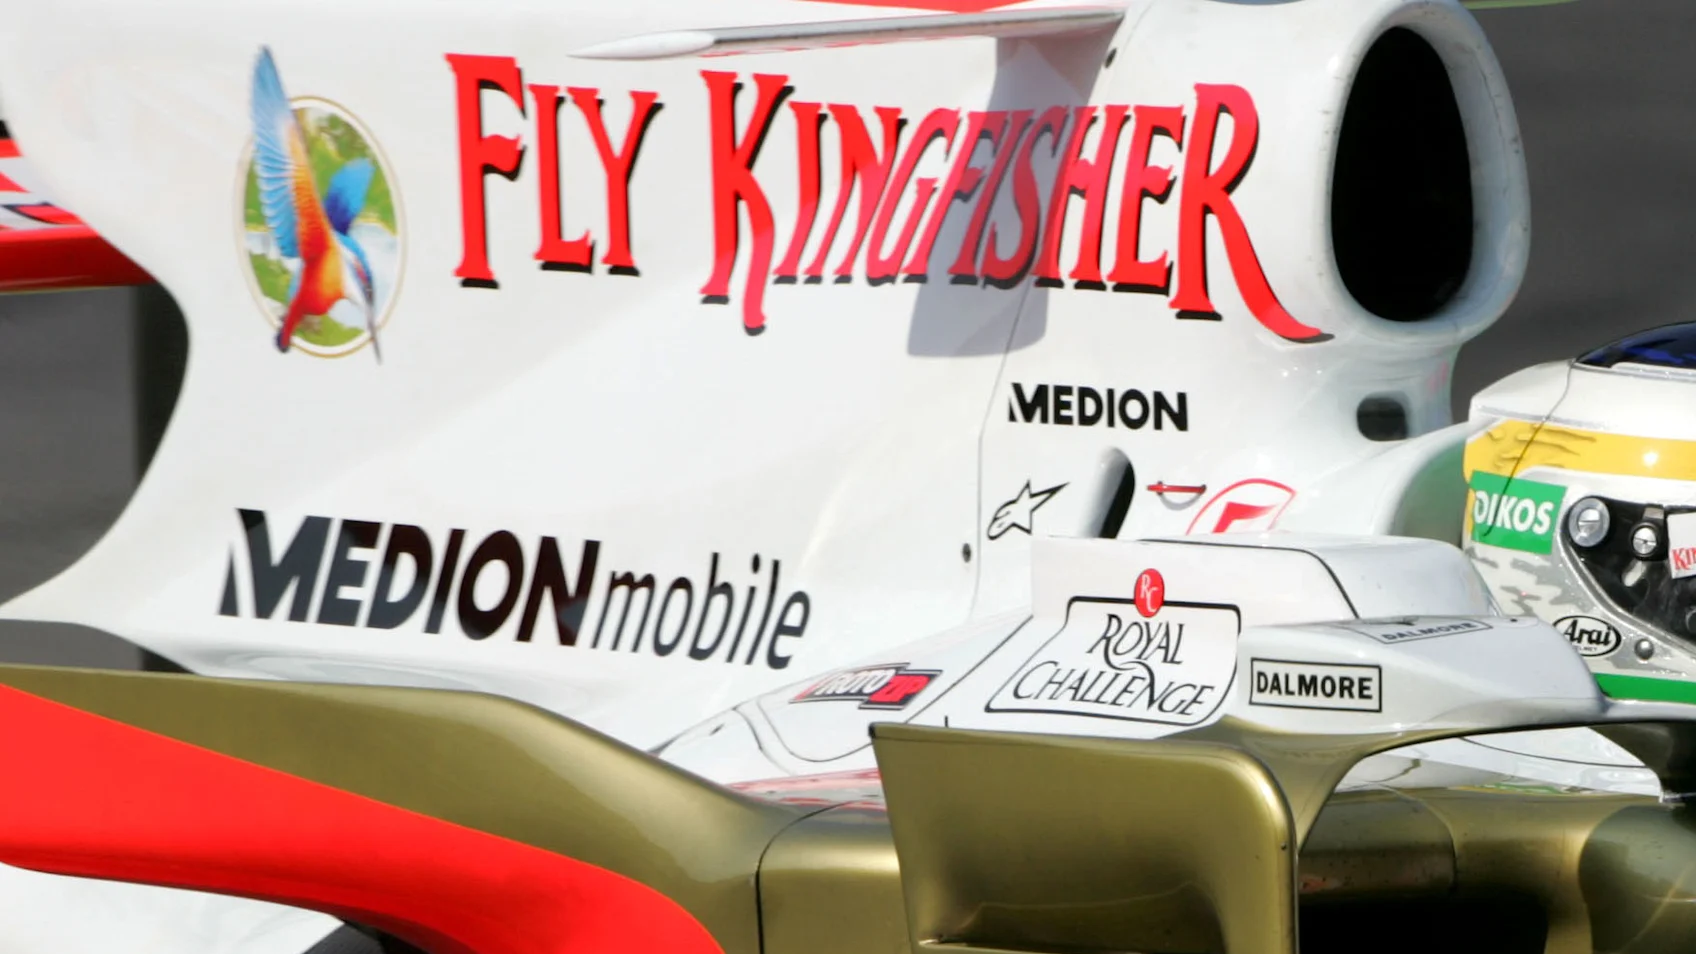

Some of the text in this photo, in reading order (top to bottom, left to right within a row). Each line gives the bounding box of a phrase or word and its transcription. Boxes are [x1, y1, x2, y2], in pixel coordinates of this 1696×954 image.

[446, 54, 1334, 343] FLY KINGFISHER
[1008, 384, 1187, 431] MEDION
[1474, 490, 1554, 535] OIKOS
[1086, 614, 1184, 670] ROYAL
[1382, 621, 1478, 641] DALMORE
[1563, 619, 1613, 646] Arai
[1013, 661, 1214, 715] CHALLENGE
[1257, 671, 1373, 700] DALMORE
